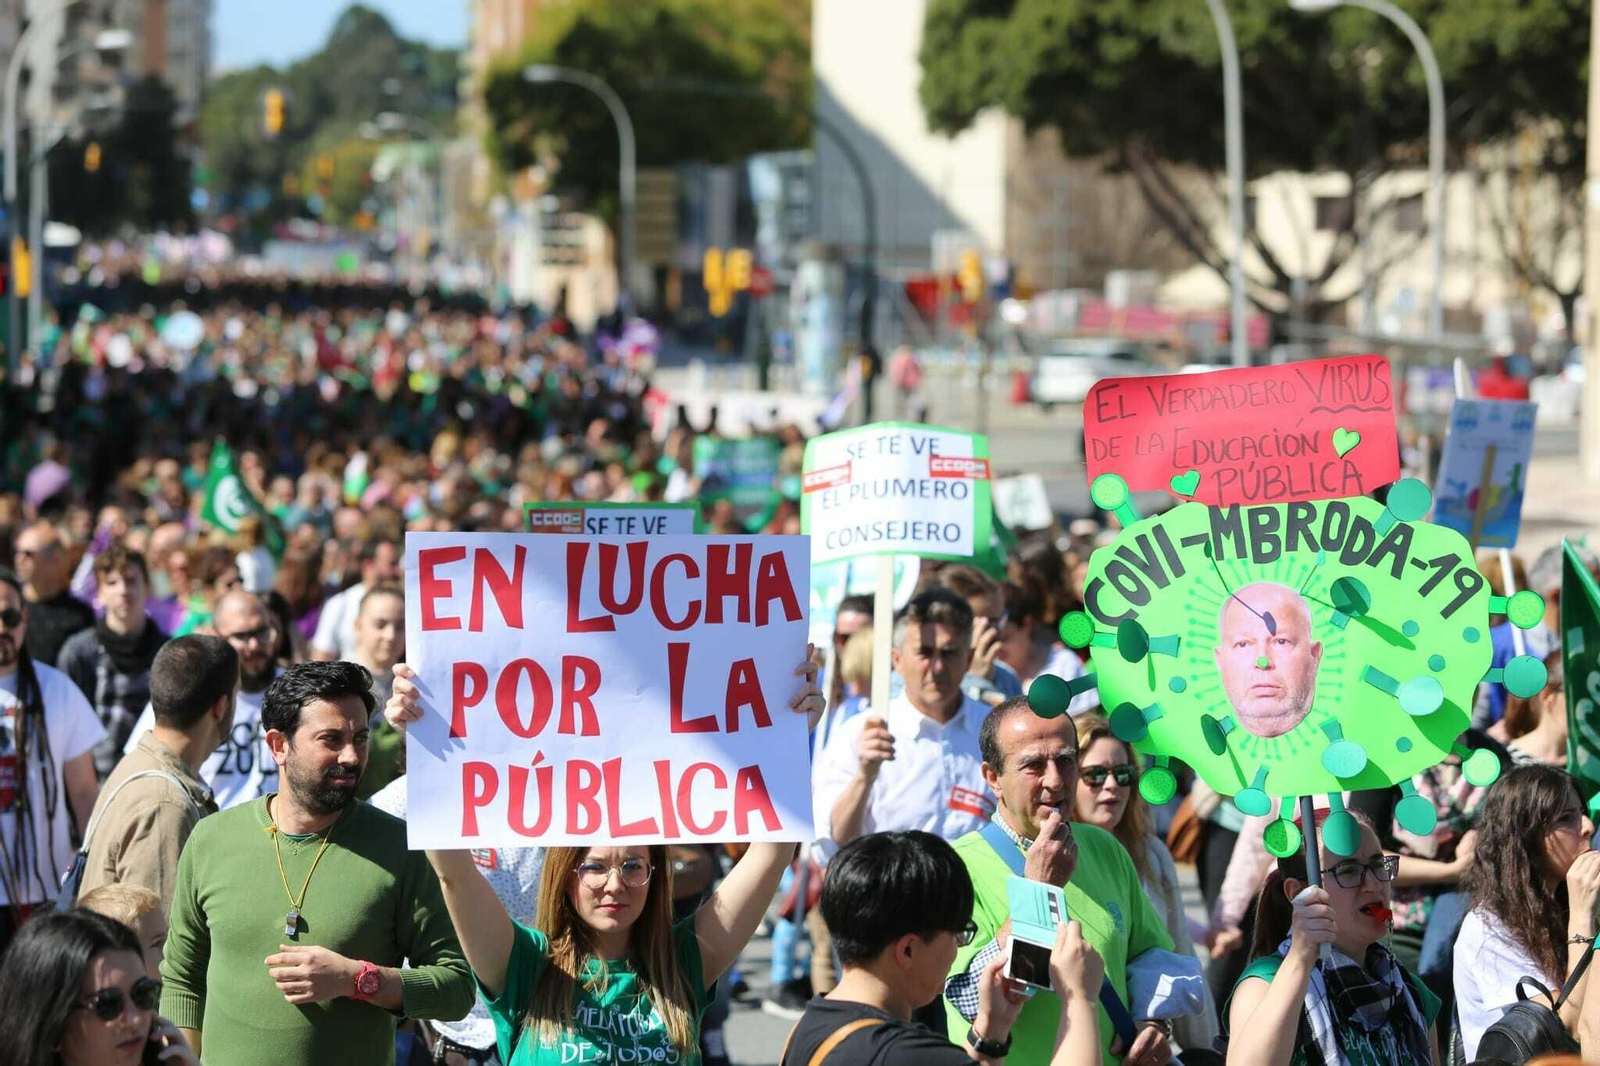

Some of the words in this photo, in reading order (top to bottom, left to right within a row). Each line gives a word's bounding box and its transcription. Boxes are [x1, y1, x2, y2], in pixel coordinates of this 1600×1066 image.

[1095, 383, 1137, 424] EL
[1146, 379, 1298, 417] VERDADERO
[1295, 359, 1392, 406] VIRUS
[846, 438, 868, 461] SE
[876, 434, 901, 455] TE
[911, 435, 941, 456] VE
[1091, 434, 1123, 463] DE
[1134, 432, 1166, 457] LA
[822, 489, 842, 511] EL
[850, 478, 969, 501] PLUMERO
[1211, 458, 1365, 506] PÚBLICA
[615, 516, 637, 535] TE
[643, 515, 668, 535] VE
[826, 519, 962, 551] CONSEJERO
[418, 543, 527, 633] EN
[566, 540, 803, 633] LUCHA
[449, 654, 602, 739] POR
[667, 642, 773, 734] LA
[461, 750, 783, 839] PÚBLICA
[560, 1041, 596, 1064] DE
